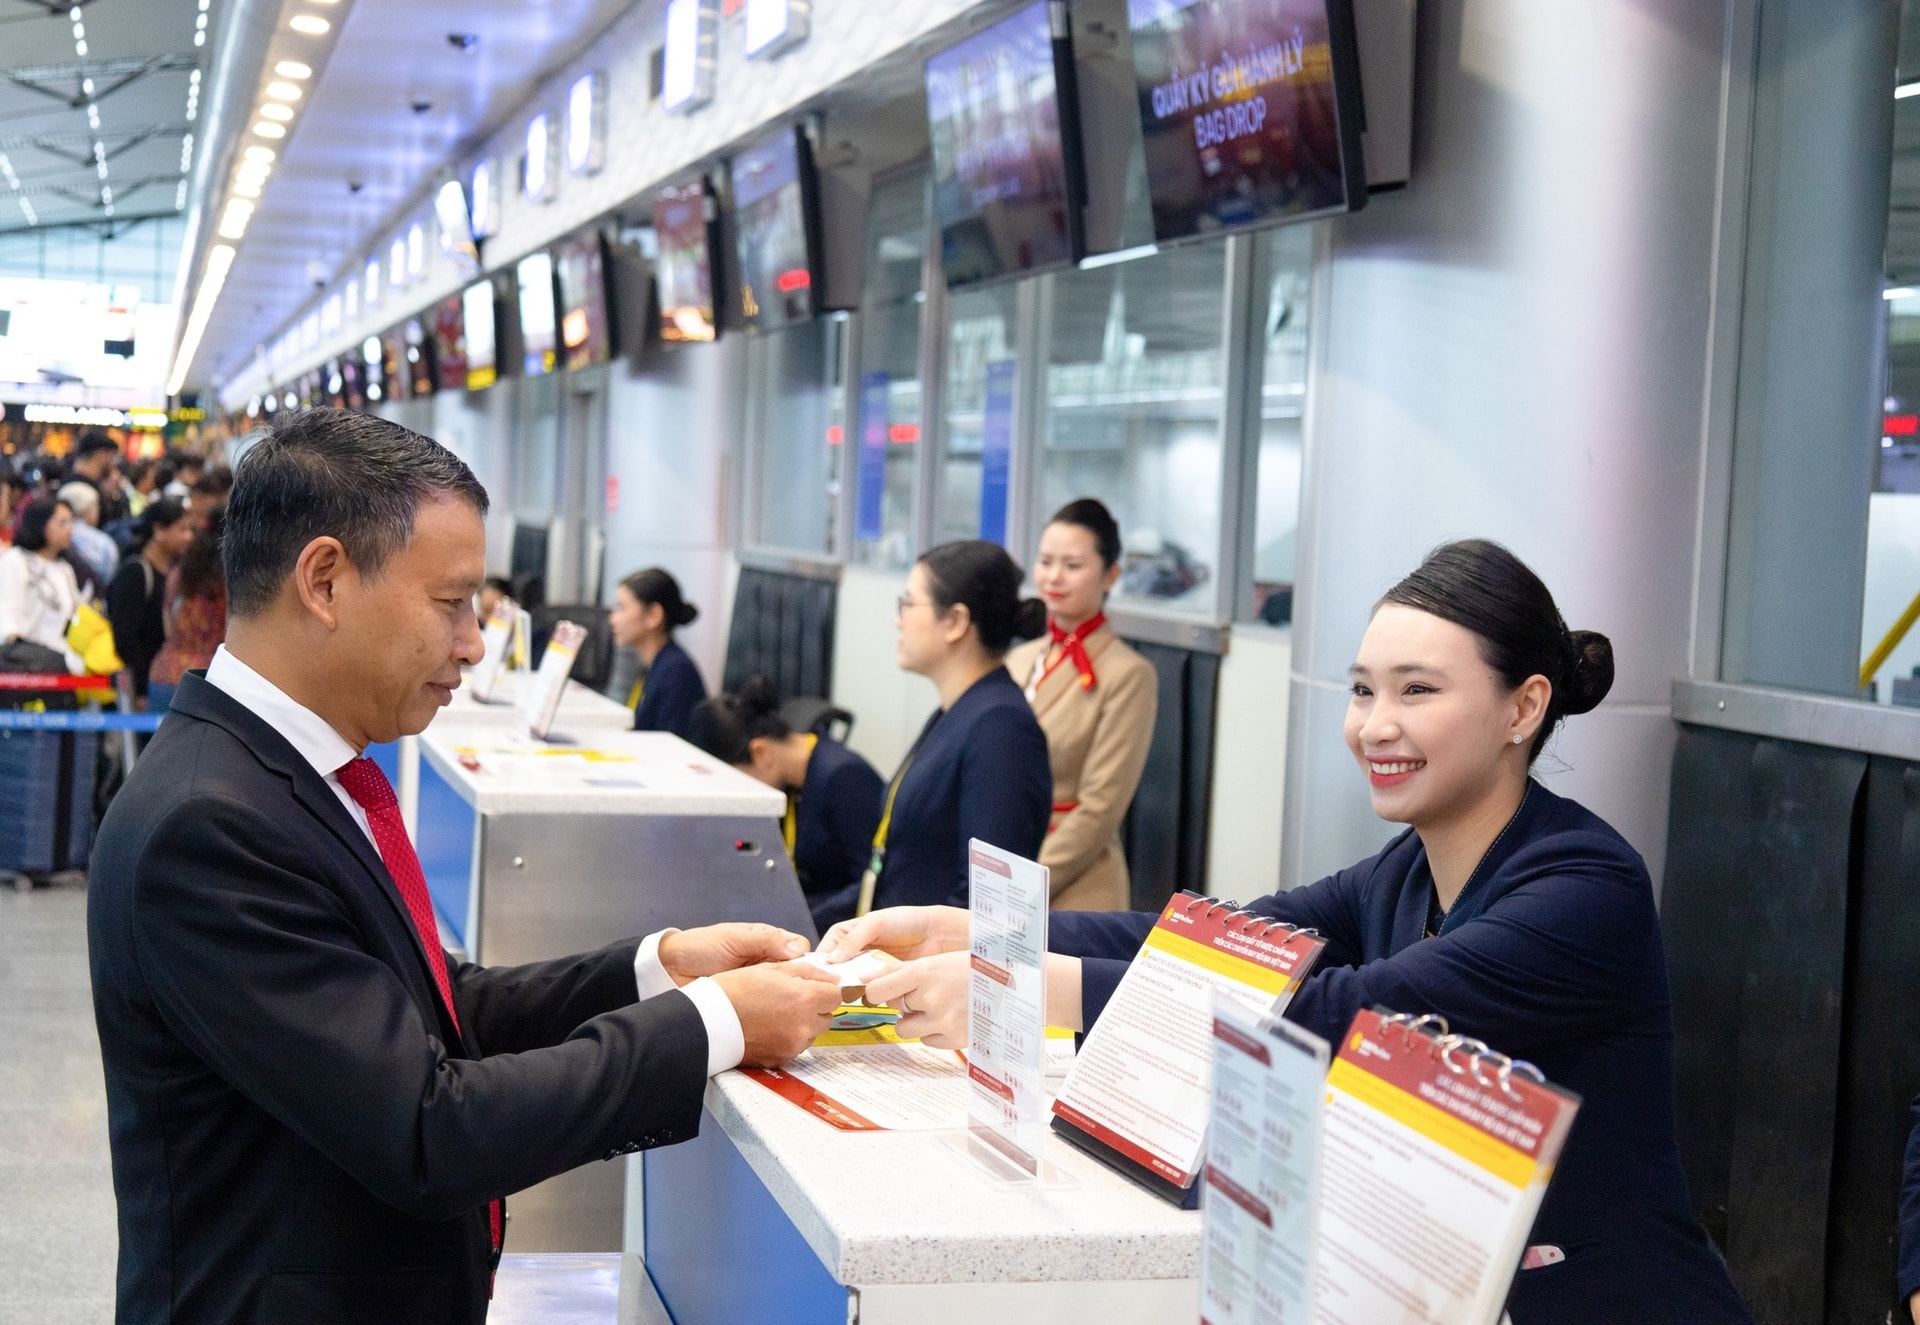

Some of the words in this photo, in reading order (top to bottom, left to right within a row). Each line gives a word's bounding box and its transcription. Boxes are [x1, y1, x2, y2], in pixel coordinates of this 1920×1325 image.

[1190, 61, 1210, 107] KÝ
[1286, 26, 1304, 74] LÝ
[1194, 113, 1226, 149] BAG
[1227, 96, 1267, 141] DROP
